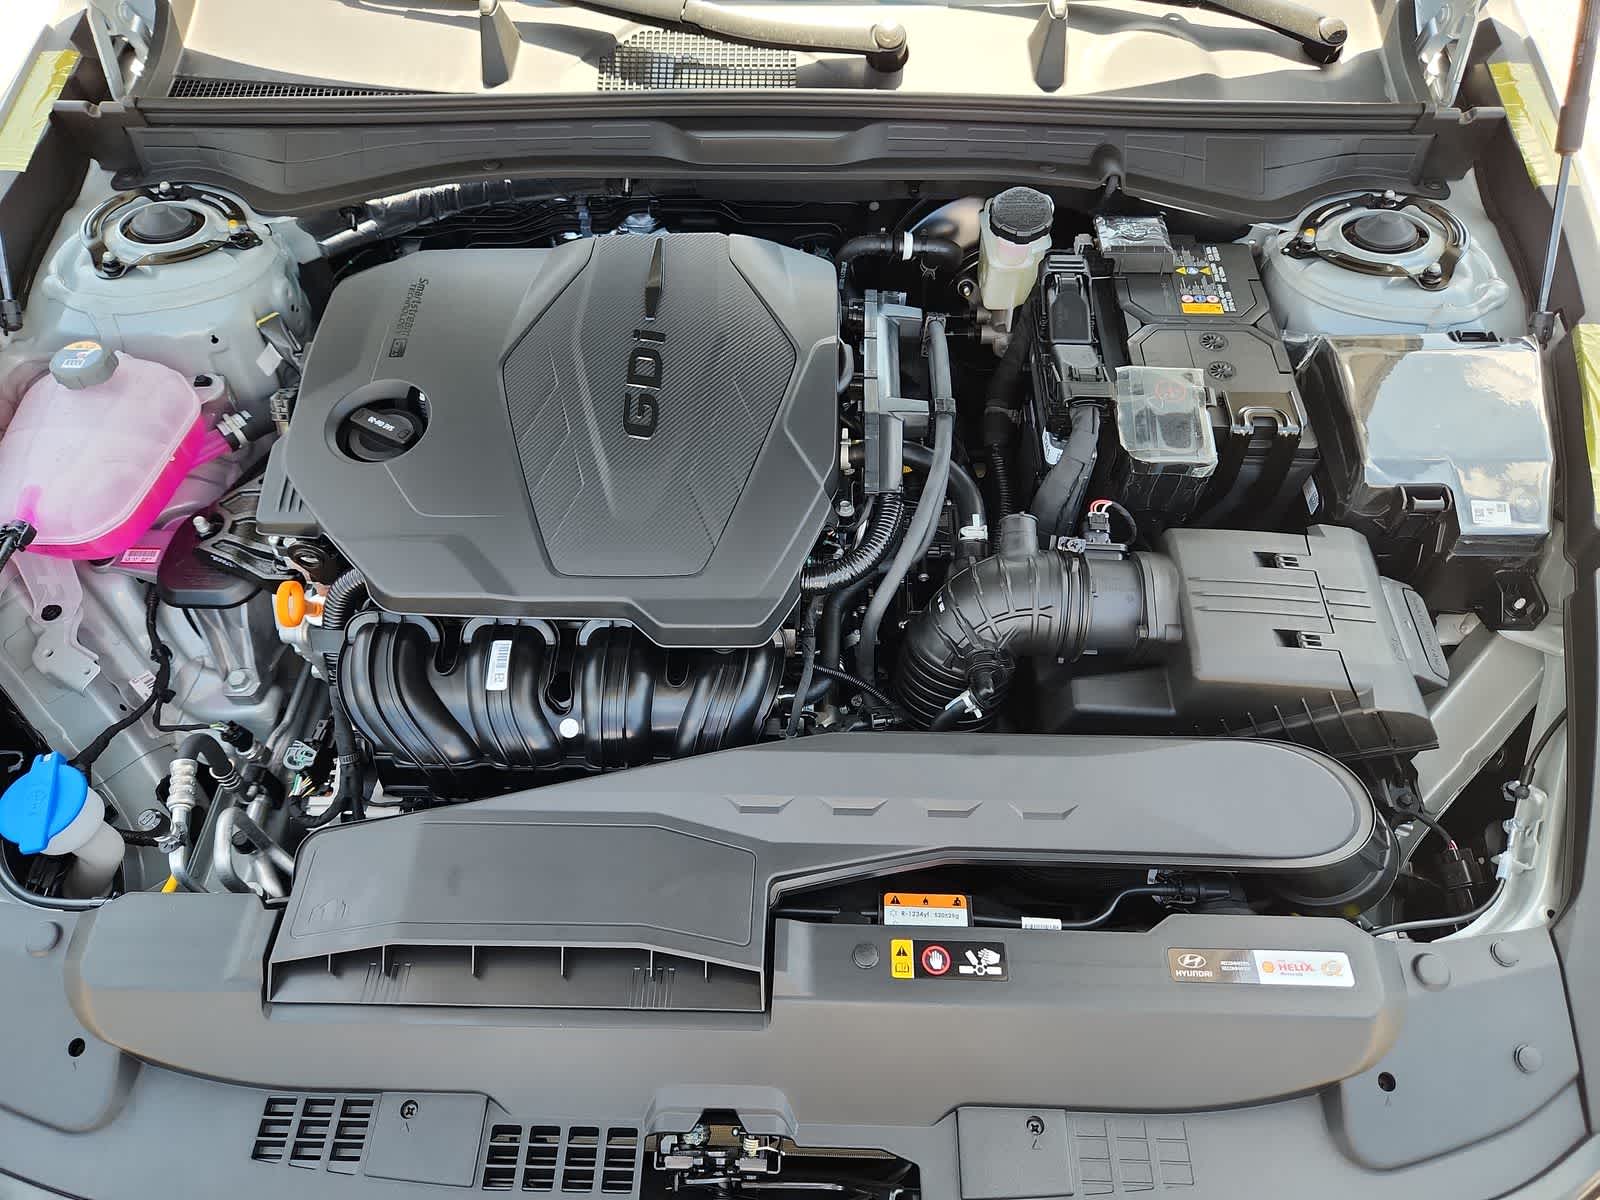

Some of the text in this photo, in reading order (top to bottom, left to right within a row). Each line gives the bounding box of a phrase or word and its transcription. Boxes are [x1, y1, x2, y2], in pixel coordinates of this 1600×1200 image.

[400, 277, 429, 336] Smartstream
[1278, 961, 1313, 972] HELIX
[1175, 969, 1213, 978] HYUNDAI
